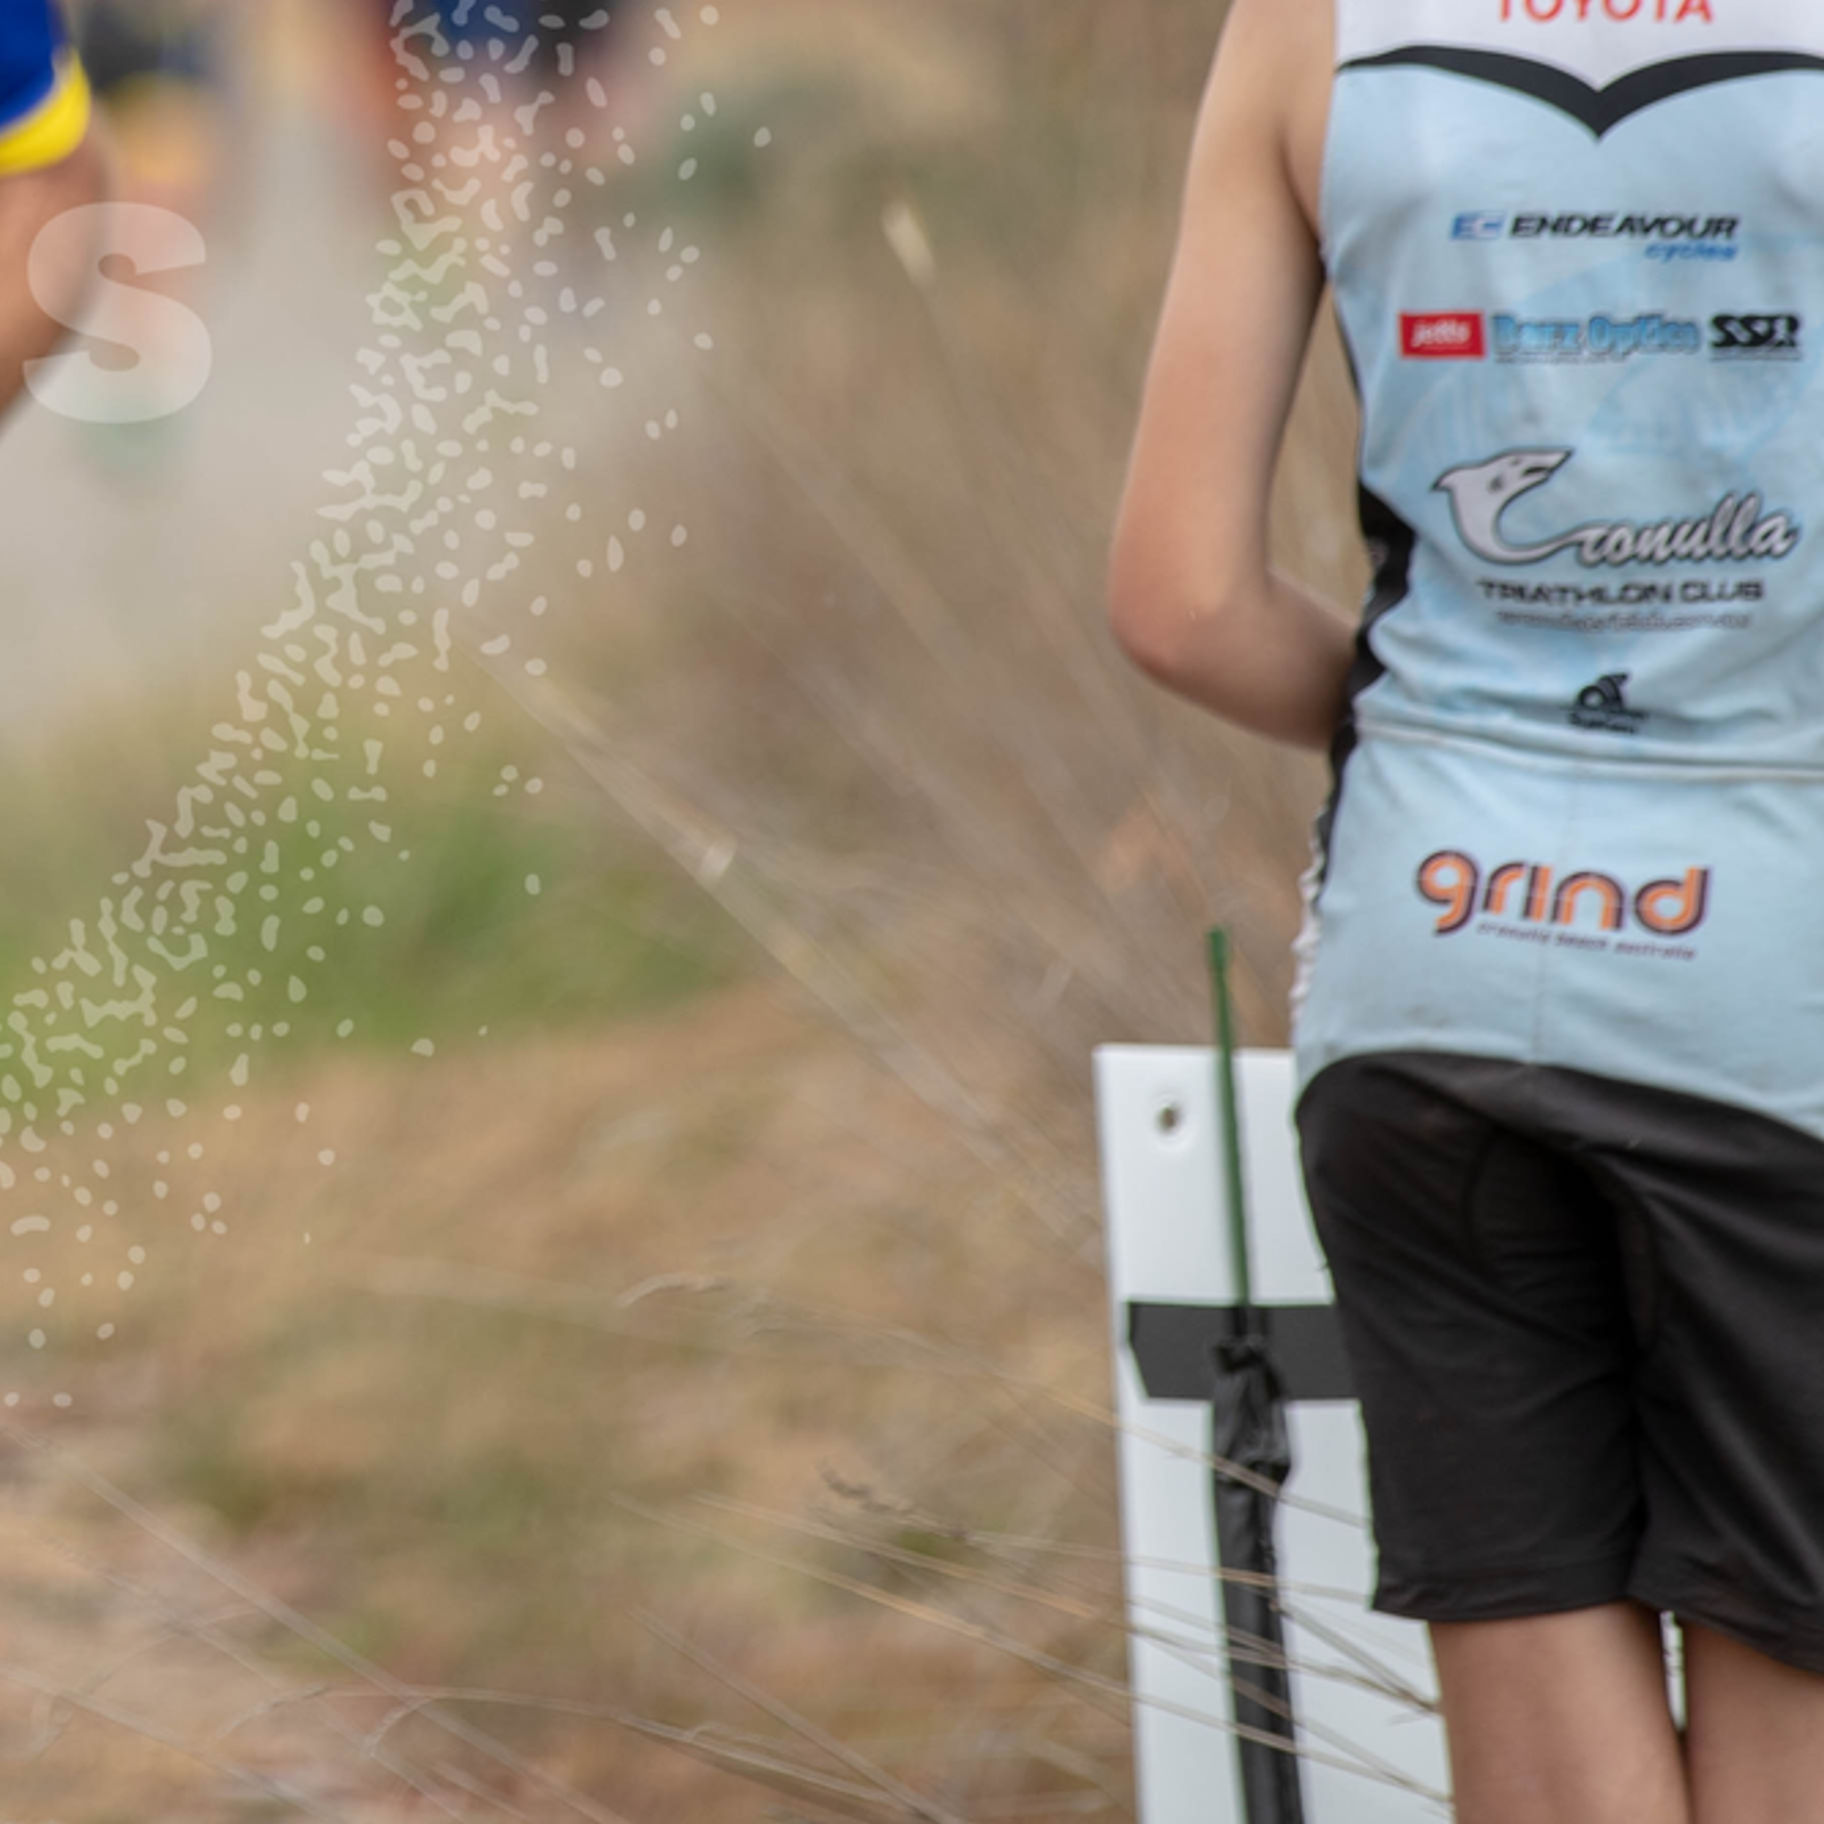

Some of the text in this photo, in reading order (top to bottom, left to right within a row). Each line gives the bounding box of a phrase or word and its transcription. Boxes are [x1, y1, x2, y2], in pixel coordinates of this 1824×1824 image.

[1510, 212, 1739, 241] ENDEAVOUR
[1478, 580, 1765, 605] TRIATHLON CLUB
[1416, 848, 1711, 936] grind
